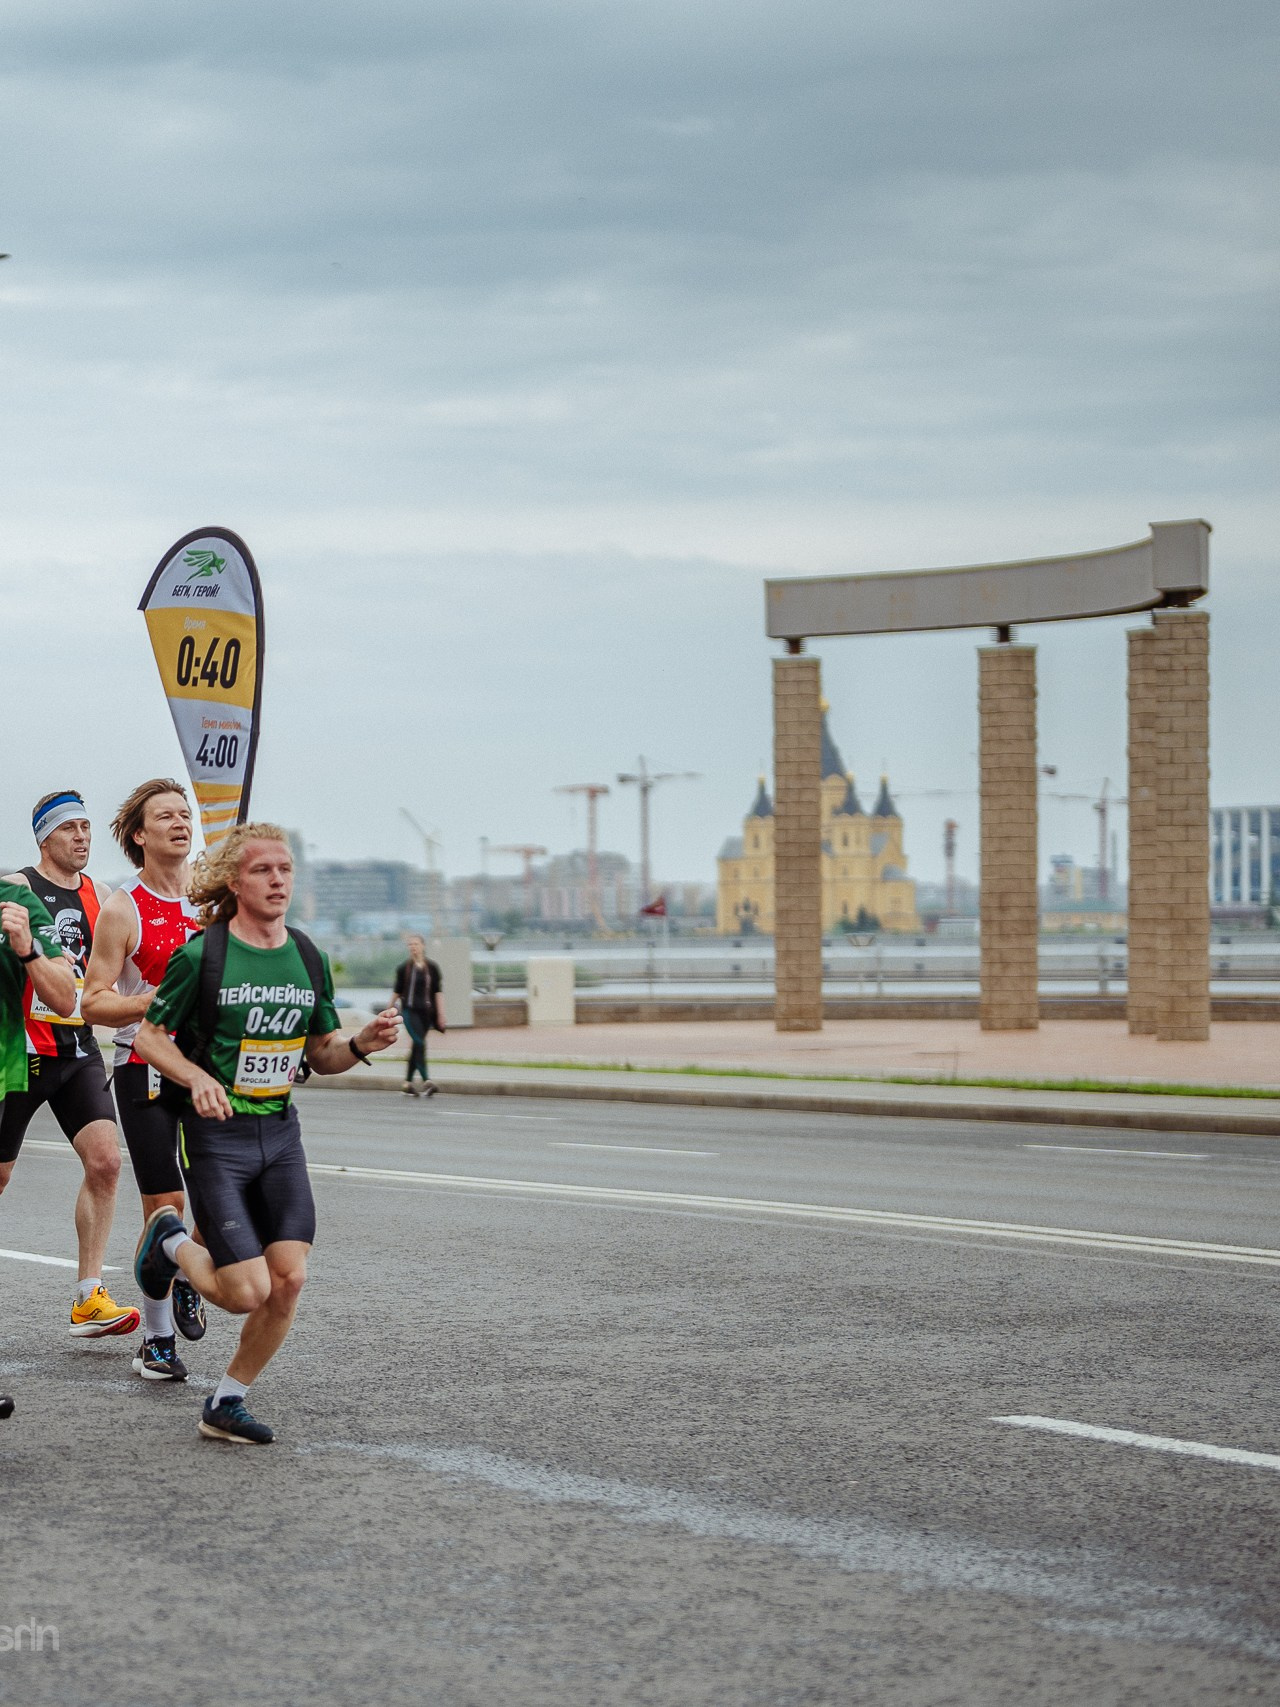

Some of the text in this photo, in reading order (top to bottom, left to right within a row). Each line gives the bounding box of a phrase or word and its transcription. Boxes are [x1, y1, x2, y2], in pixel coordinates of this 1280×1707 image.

[171, 583, 220, 599] БЕГИ, ГЕРОЙ!
[176, 635, 241, 689] 0:40
[195, 733, 239, 769] 4:00
[217, 982, 316, 1006] ПЕЙСМЕЙКЕ
[245, 1006, 302, 1034] 0:40
[244, 1055, 290, 1073] 5318
[240, 1076, 271, 1084] ЯРОСЛАВ
